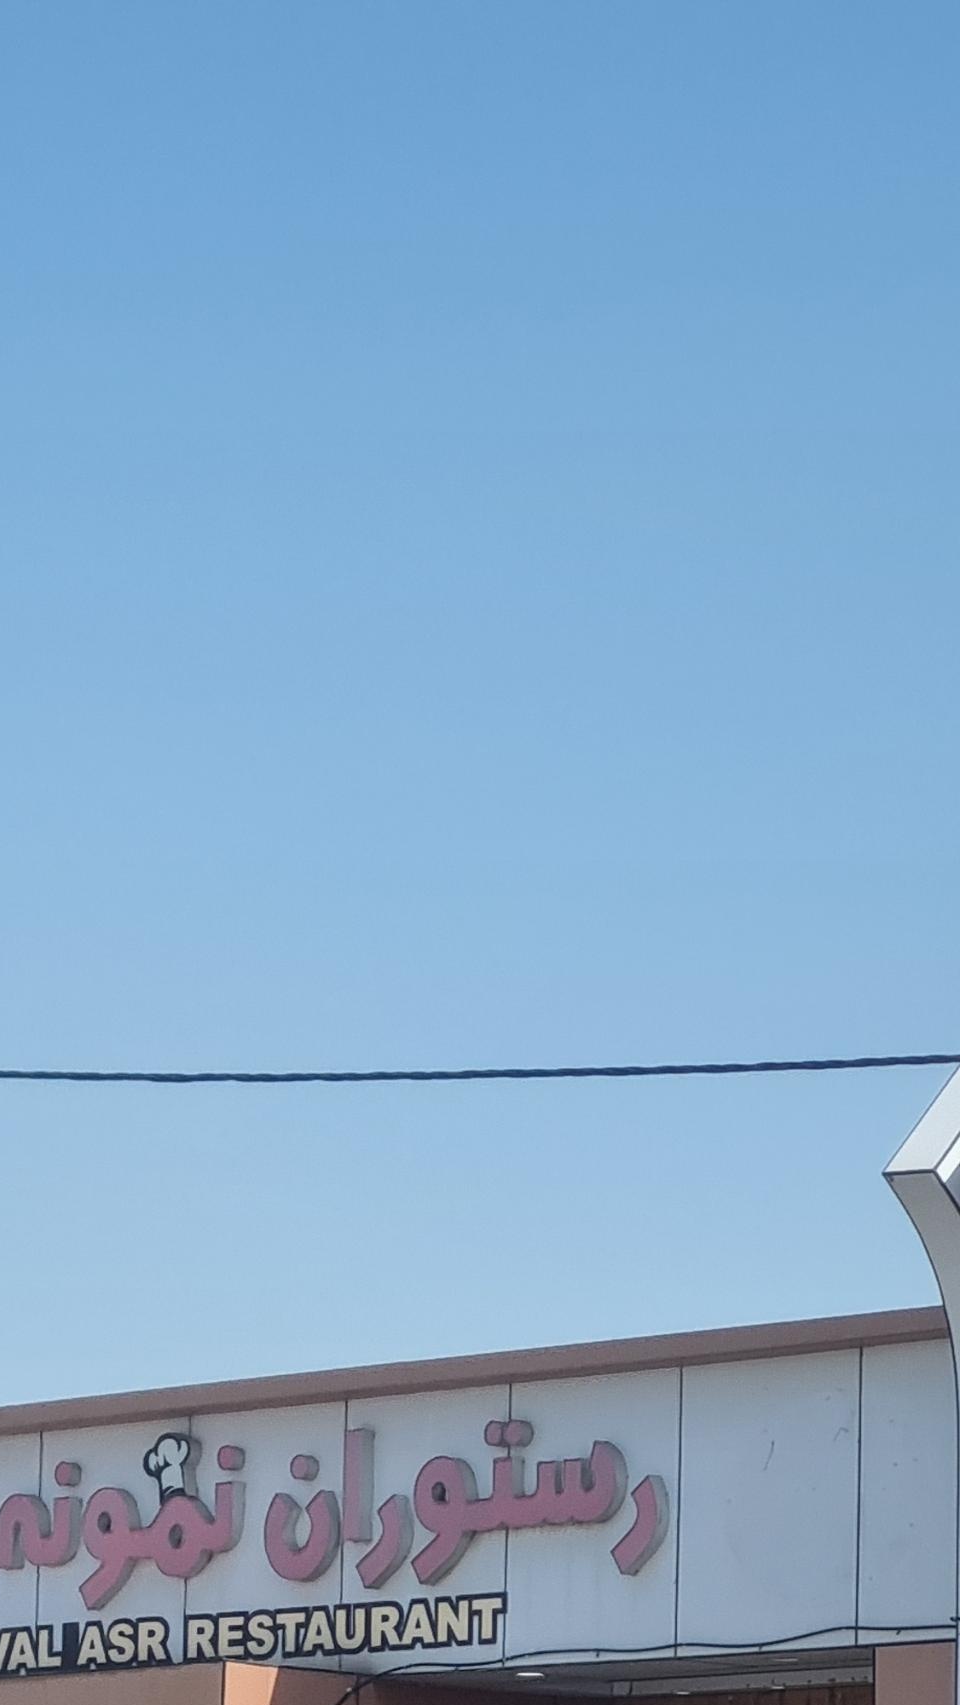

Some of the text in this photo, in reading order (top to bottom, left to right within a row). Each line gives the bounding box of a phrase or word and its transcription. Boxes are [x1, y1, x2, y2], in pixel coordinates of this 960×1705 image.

[263, 1418, 668, 1590] رستوران
[76, 1617, 171, 1667] ASR
[186, 1593, 507, 1661] RESTAURANT
